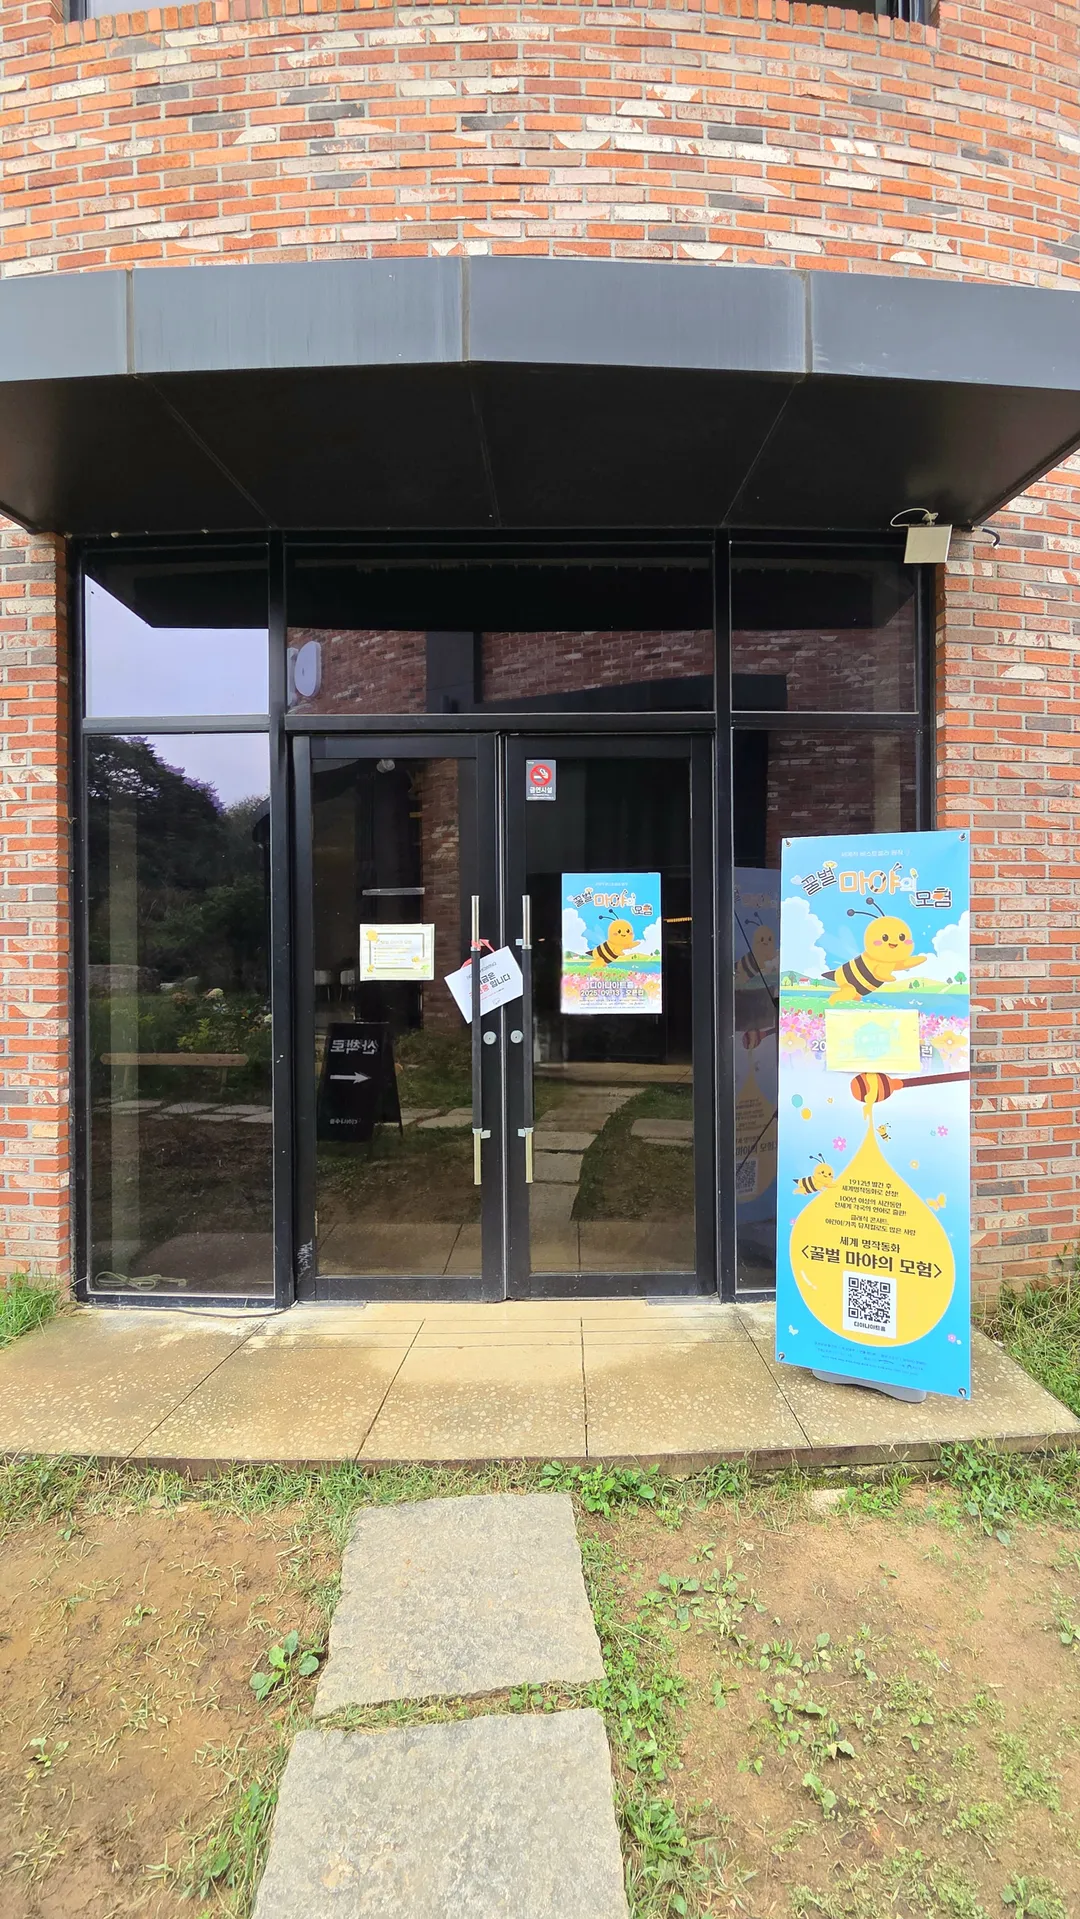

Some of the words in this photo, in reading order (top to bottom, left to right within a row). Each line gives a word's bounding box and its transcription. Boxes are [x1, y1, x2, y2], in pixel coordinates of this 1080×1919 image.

[529, 786, 552, 794] 금연시설
[801, 867, 837, 896] 꿀벌
[839, 868, 916, 895] 마야의
[490, 973, 511, 988] 입니다
[849, 1179, 871, 1187] 1912년
[840, 1195, 857, 1203] 100년
[858, 1197, 876, 1206] 이상의
[854, 1204, 871, 1212] 각국의
[840, 1236, 859, 1248] 세계
[861, 1239, 900, 1254] 명작동화
[801, 1245, 840, 1264] <꿀벌
[845, 1250, 893, 1272] 마야의
[900, 1259, 942, 1278] 모험>
